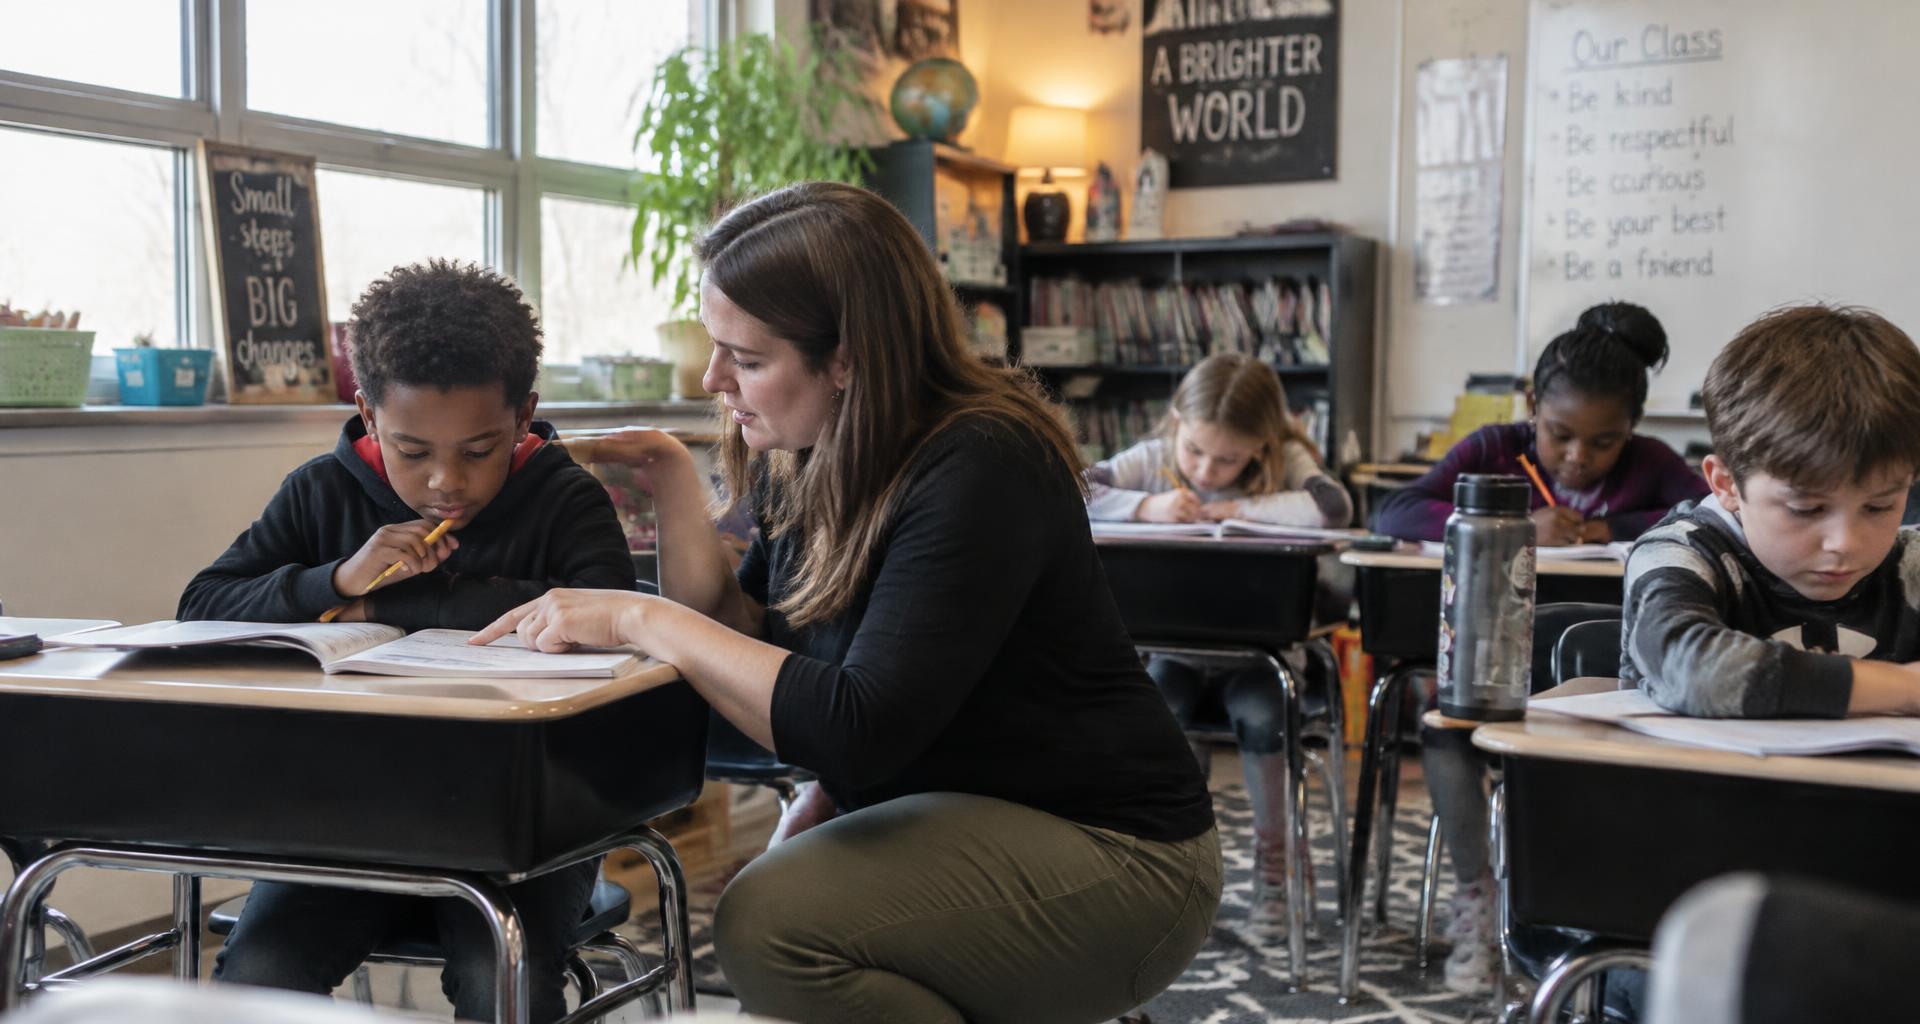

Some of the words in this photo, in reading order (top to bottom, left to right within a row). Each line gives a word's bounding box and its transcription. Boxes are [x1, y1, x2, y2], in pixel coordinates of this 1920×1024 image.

[1151, 45, 1173, 86] A
[1179, 34, 1323, 84] BRIGHTER
[1572, 29, 1628, 64] Our
[1640, 23, 1723, 57] Class
[1167, 85, 1306, 144] WORLD
[1566, 80, 1599, 113] Be
[1614, 78, 1673, 107] kind
[1565, 124, 1597, 156] Be
[1609, 114, 1735, 161] respectful
[230, 171, 295, 218] Small
[1565, 166, 1597, 197] Be
[240, 218, 294, 270] steps
[1564, 208, 1596, 240] Be
[1607, 214, 1661, 249] your
[1672, 204, 1727, 234] best
[1563, 250, 1596, 281] Be
[1607, 260, 1622, 280] a
[245, 276, 298, 328] BIG
[236, 330, 316, 379] changes
